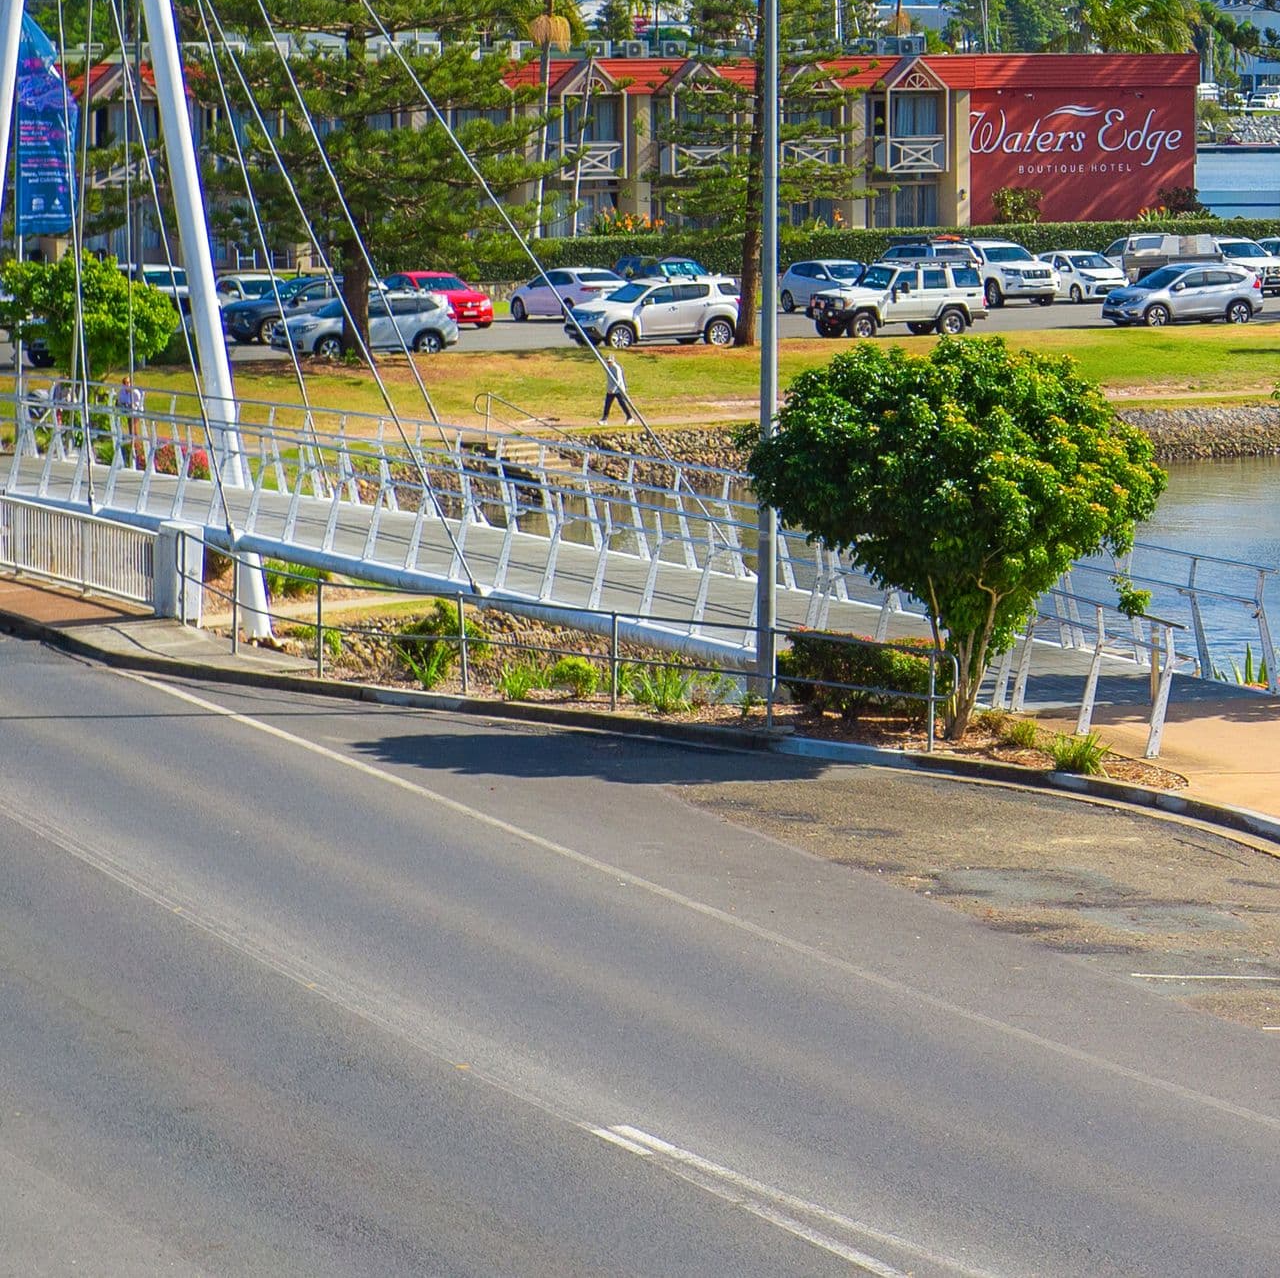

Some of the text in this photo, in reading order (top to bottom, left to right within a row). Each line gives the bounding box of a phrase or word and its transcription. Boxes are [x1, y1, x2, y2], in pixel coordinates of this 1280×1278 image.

[968, 108, 1183, 166] Waters Edge
[1018, 163, 1132, 174] BOUTIQUE HOTEL
